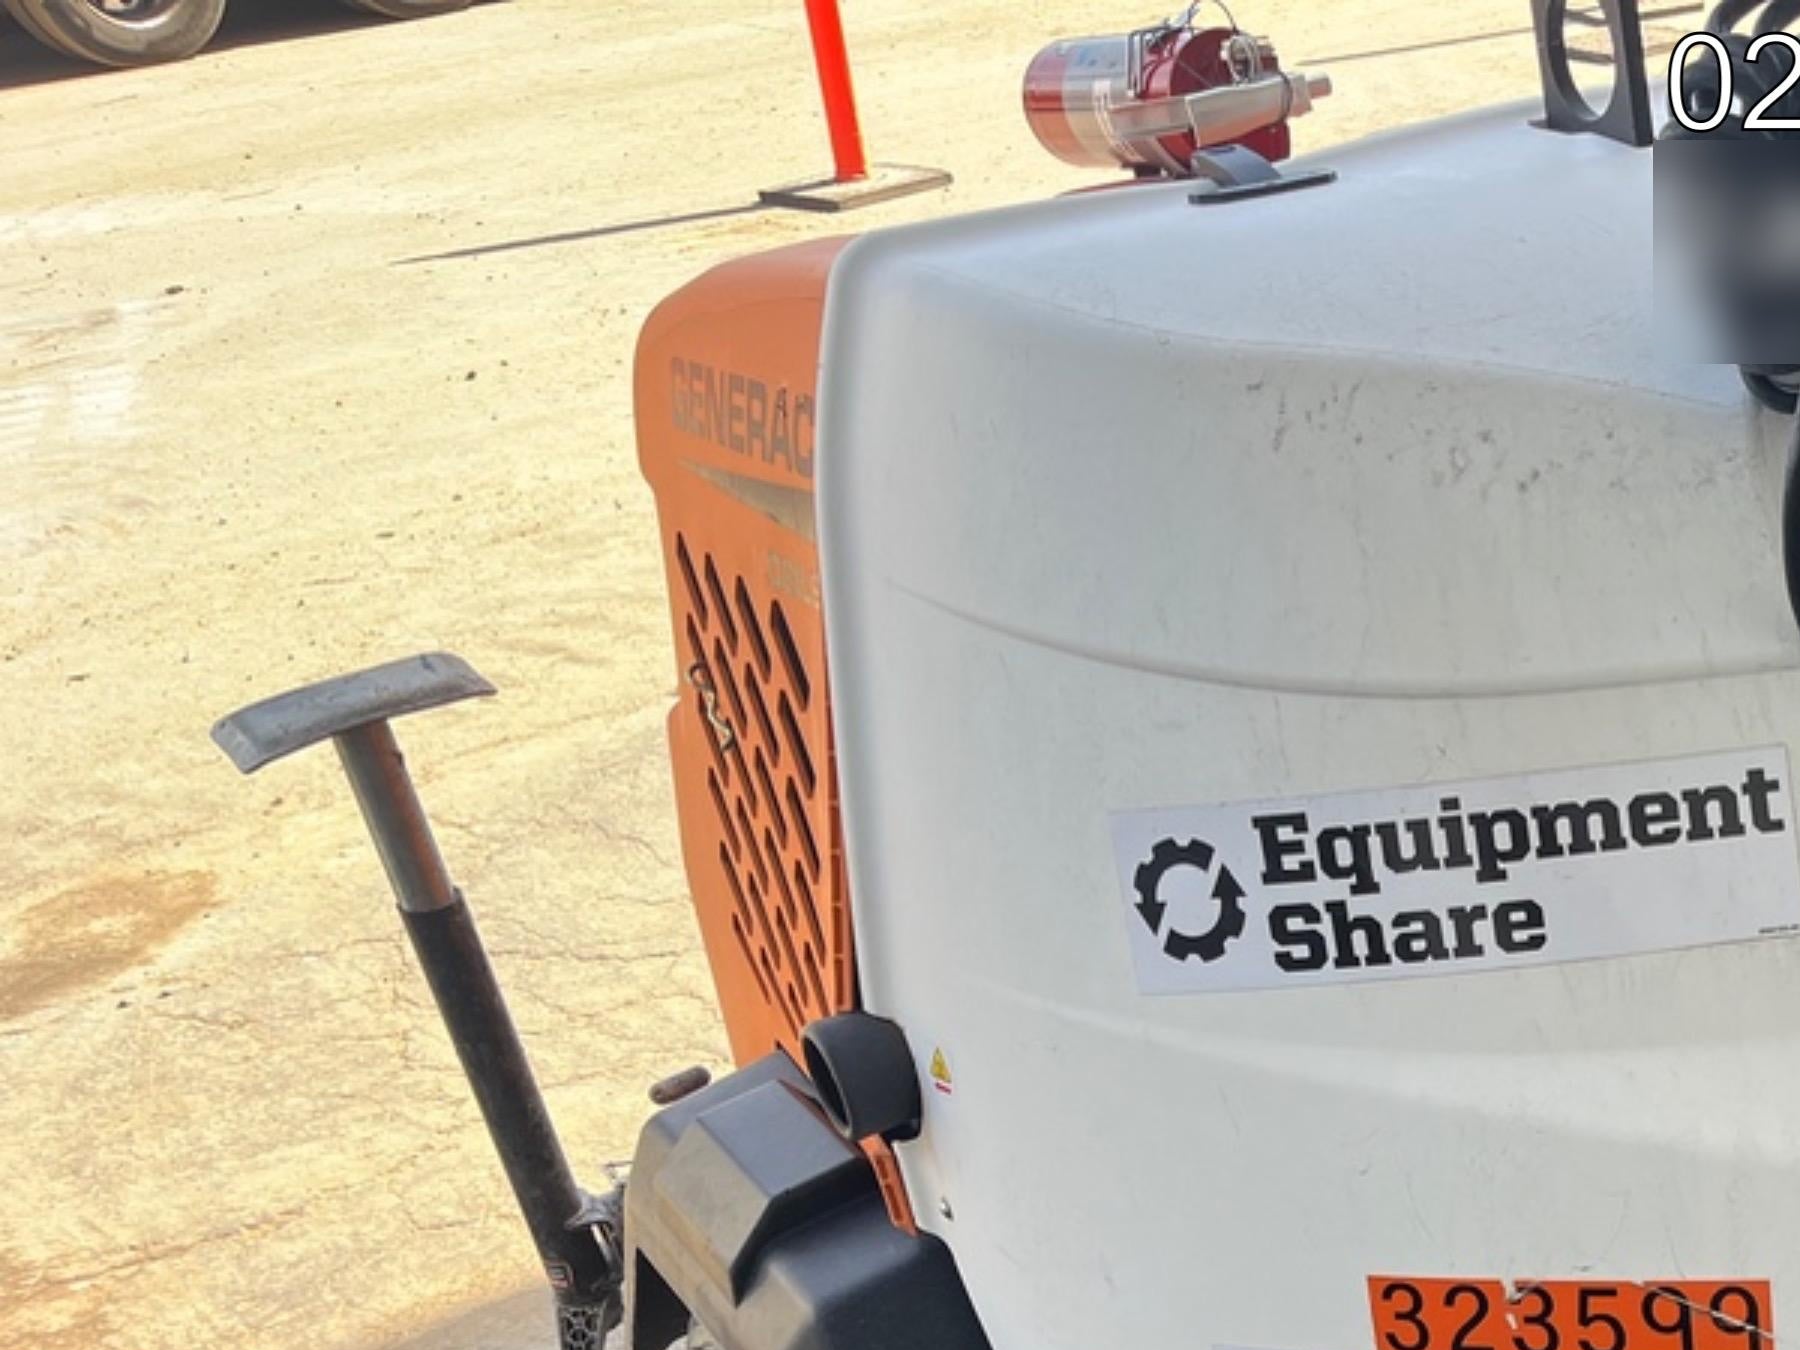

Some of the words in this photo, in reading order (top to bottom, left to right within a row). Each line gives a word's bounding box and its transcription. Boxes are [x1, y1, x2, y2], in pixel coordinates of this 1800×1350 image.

[672, 355, 815, 478] GENERAC
[1250, 767, 1785, 895] Equipment
[1267, 897, 1547, 974] Share
